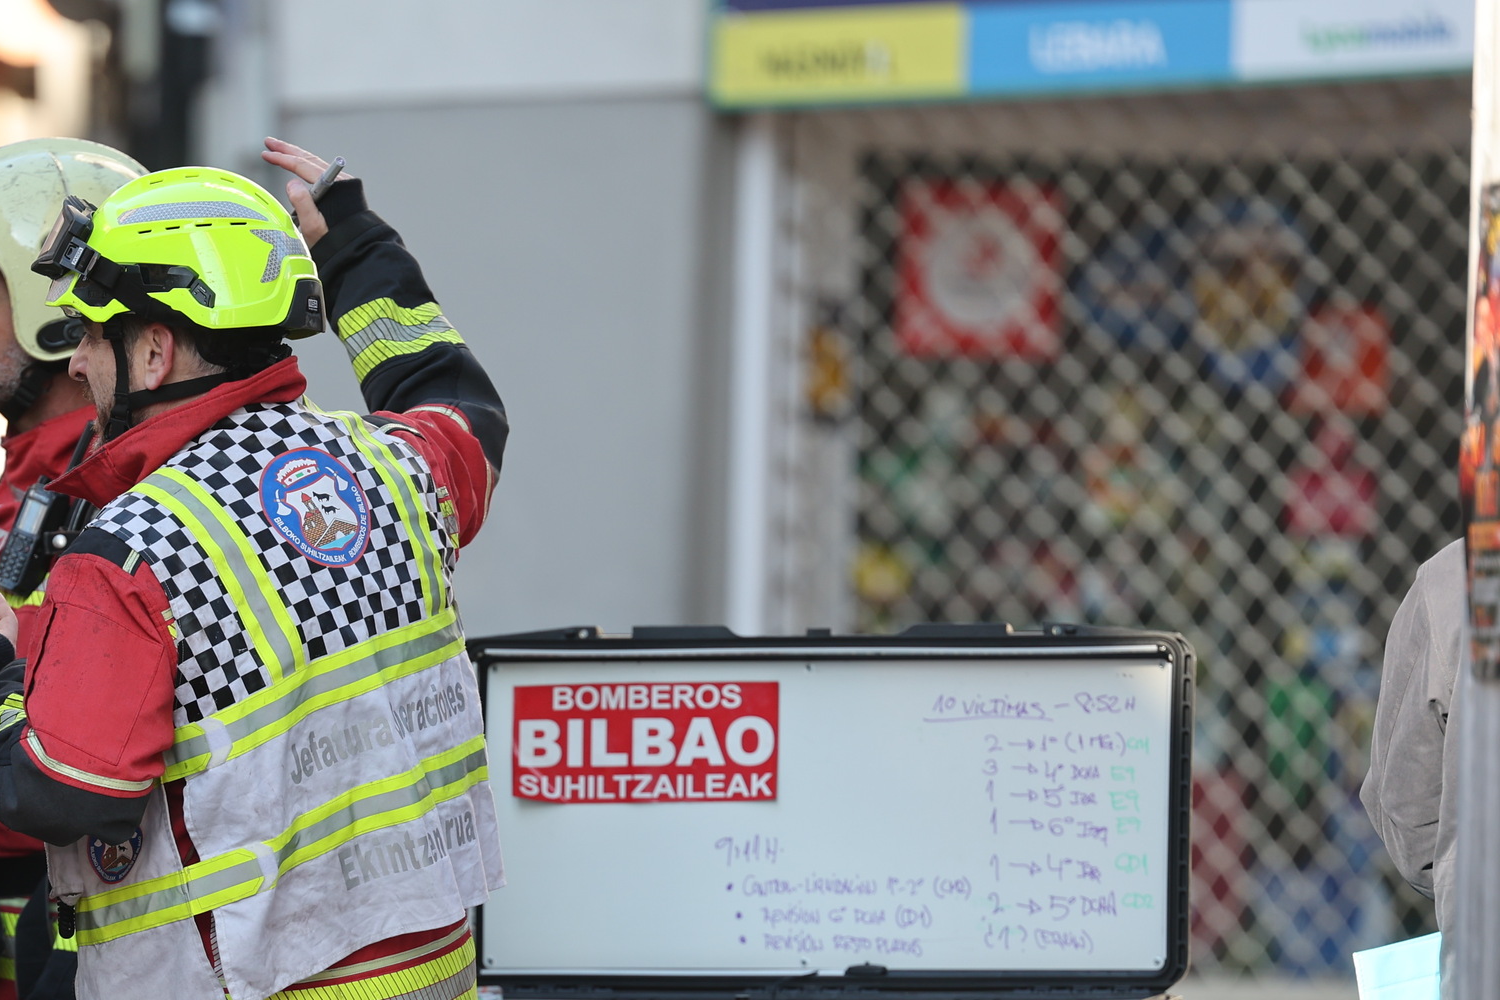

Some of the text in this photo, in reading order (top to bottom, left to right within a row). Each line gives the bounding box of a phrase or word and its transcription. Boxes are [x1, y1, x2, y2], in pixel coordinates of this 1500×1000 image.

[273, 516, 301, 545] BILBOKO
[348, 485, 367, 558] BOMBEROS DE BILBAO
[299, 542, 347, 563] SUHILTZAILEAK
[552, 684, 743, 712] BOMBEROS
[290, 714, 395, 785] Jefatura
[518, 715, 776, 768] BILBAO
[984, 733, 1003, 753] 2
[982, 758, 998, 776] 3
[518, 772, 773, 800] SUHILTZAILEAK
[985, 779, 995, 802] 1
[1108, 789, 1141, 814] E9
[989, 807, 998, 835] 1
[338, 811, 476, 891] Ekintzen rua
[989, 853, 999, 882] 1
[987, 891, 1005, 915] 2
